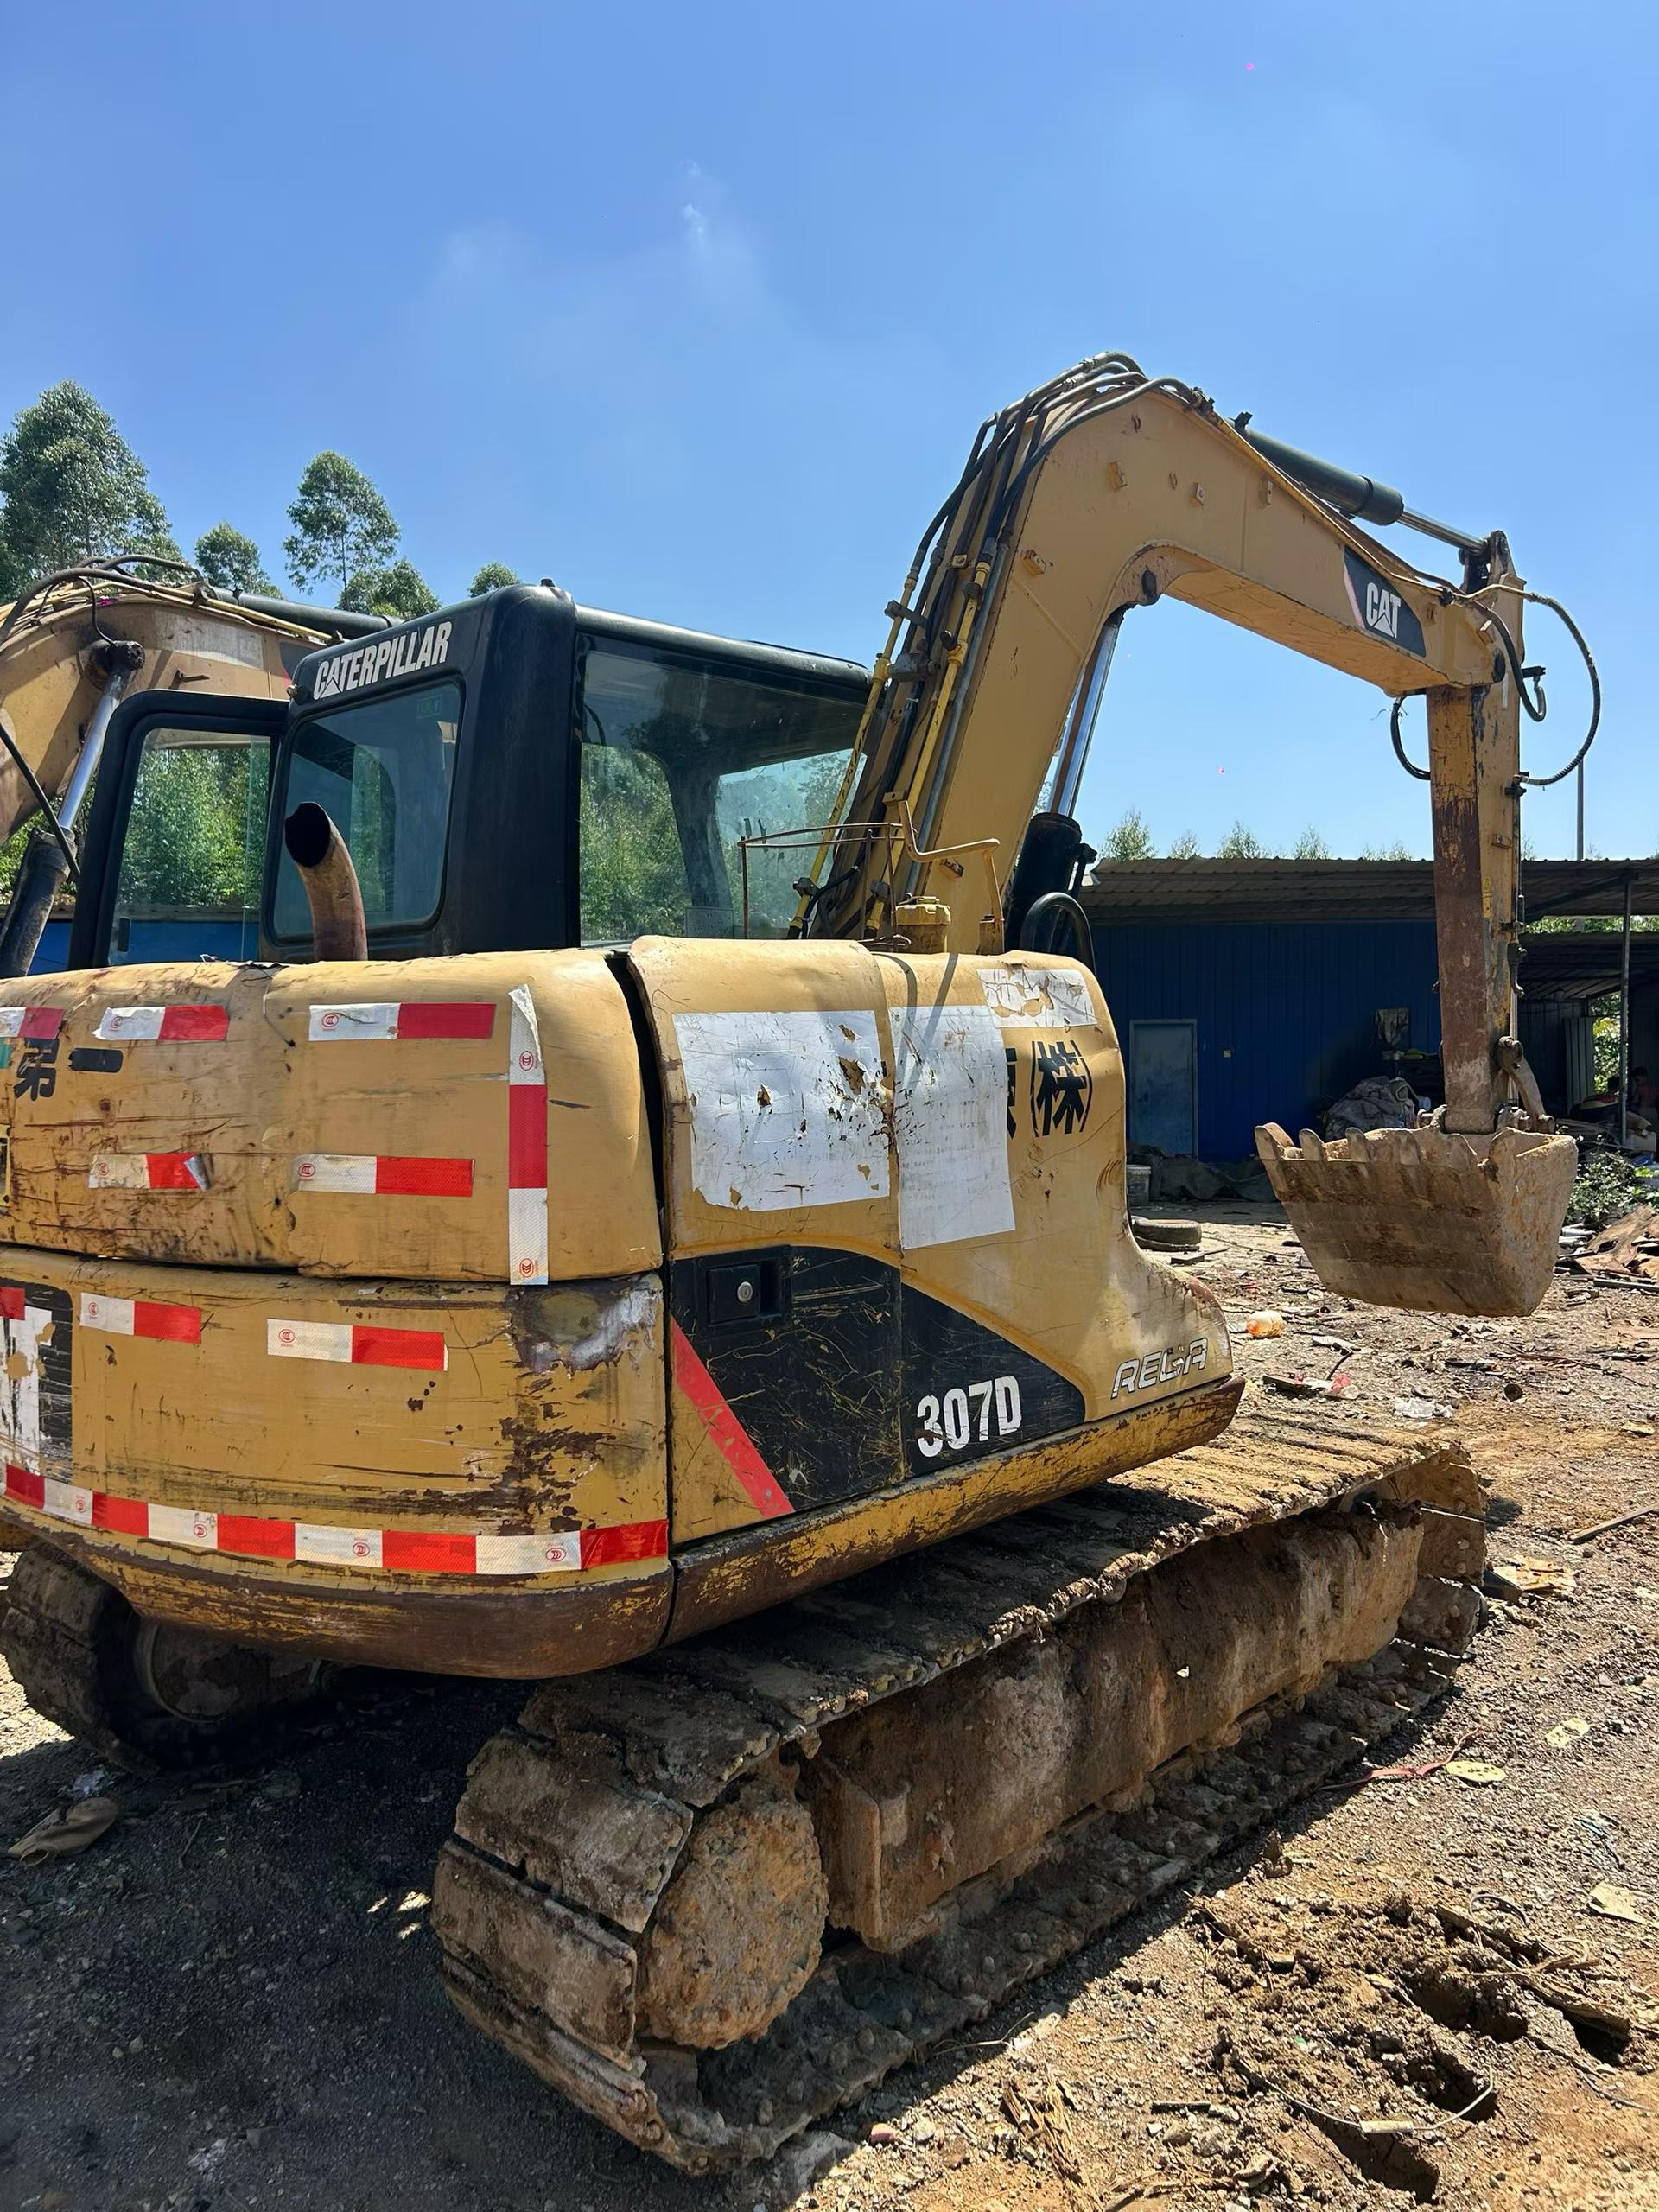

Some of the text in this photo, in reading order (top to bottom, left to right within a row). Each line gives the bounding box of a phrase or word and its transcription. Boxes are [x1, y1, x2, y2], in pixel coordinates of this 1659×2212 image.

[1366, 582, 1401, 639] CAT
[314, 621, 452, 700] CATERPILLAR
[917, 1375, 1022, 1458] 307D
